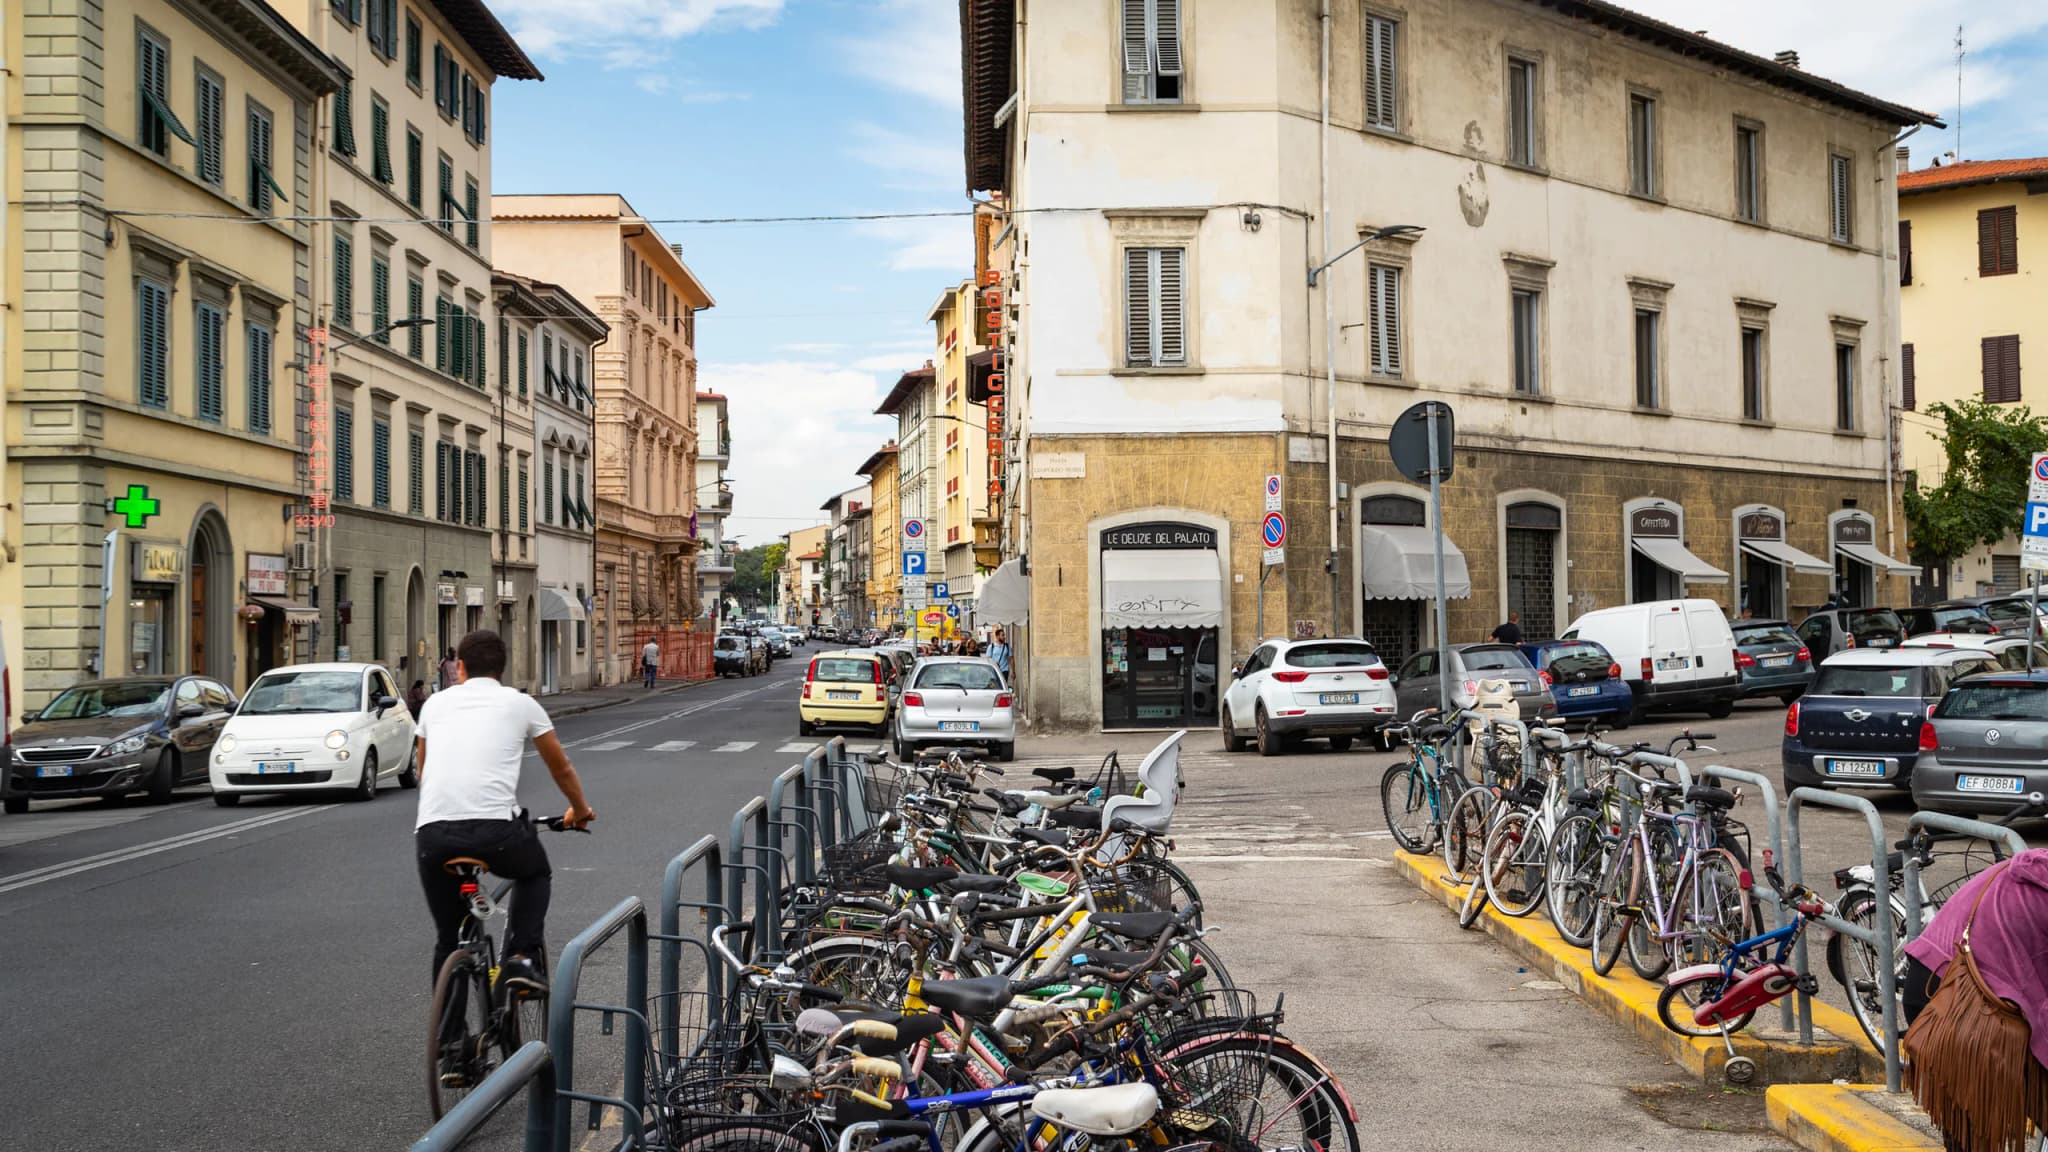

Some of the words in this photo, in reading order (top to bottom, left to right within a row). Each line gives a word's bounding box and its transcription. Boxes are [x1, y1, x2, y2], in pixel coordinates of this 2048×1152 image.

[986, 269, 1004, 495] ROSTICCERIA
[1107, 533, 1118, 544] LE
[1121, 532, 1152, 544] DELIZIE
[1155, 532, 1171, 544] DEL
[1174, 532, 1210, 544] PALATO
[907, 555, 921, 573] P
[937, 585, 945, 596] P
[1835, 762, 1846, 772] EY
[1850, 763, 1878, 773] 125AX
[1966, 777, 1979, 788] EF
